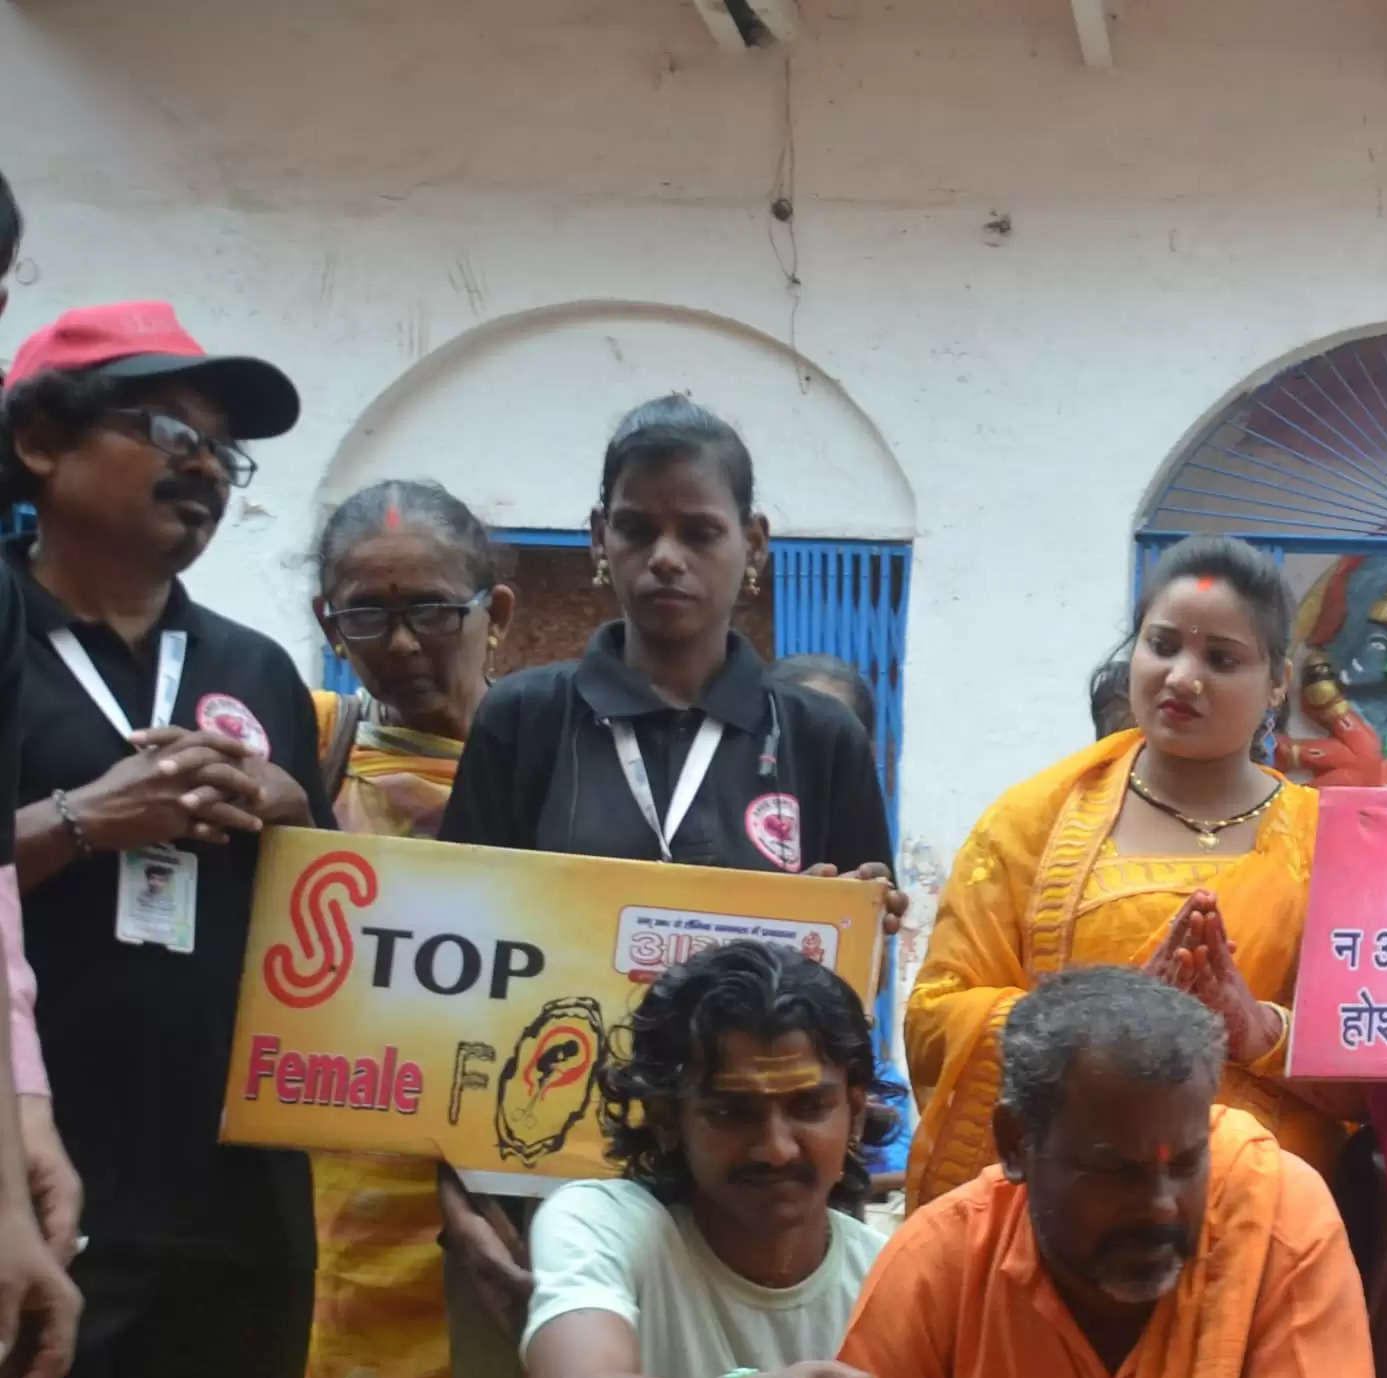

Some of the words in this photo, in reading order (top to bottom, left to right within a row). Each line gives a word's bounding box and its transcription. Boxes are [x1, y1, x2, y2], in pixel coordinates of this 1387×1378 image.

[263, 850, 545, 1008] STOP
[1334, 931, 1360, 967] न
[244, 1033, 424, 1114] Female
